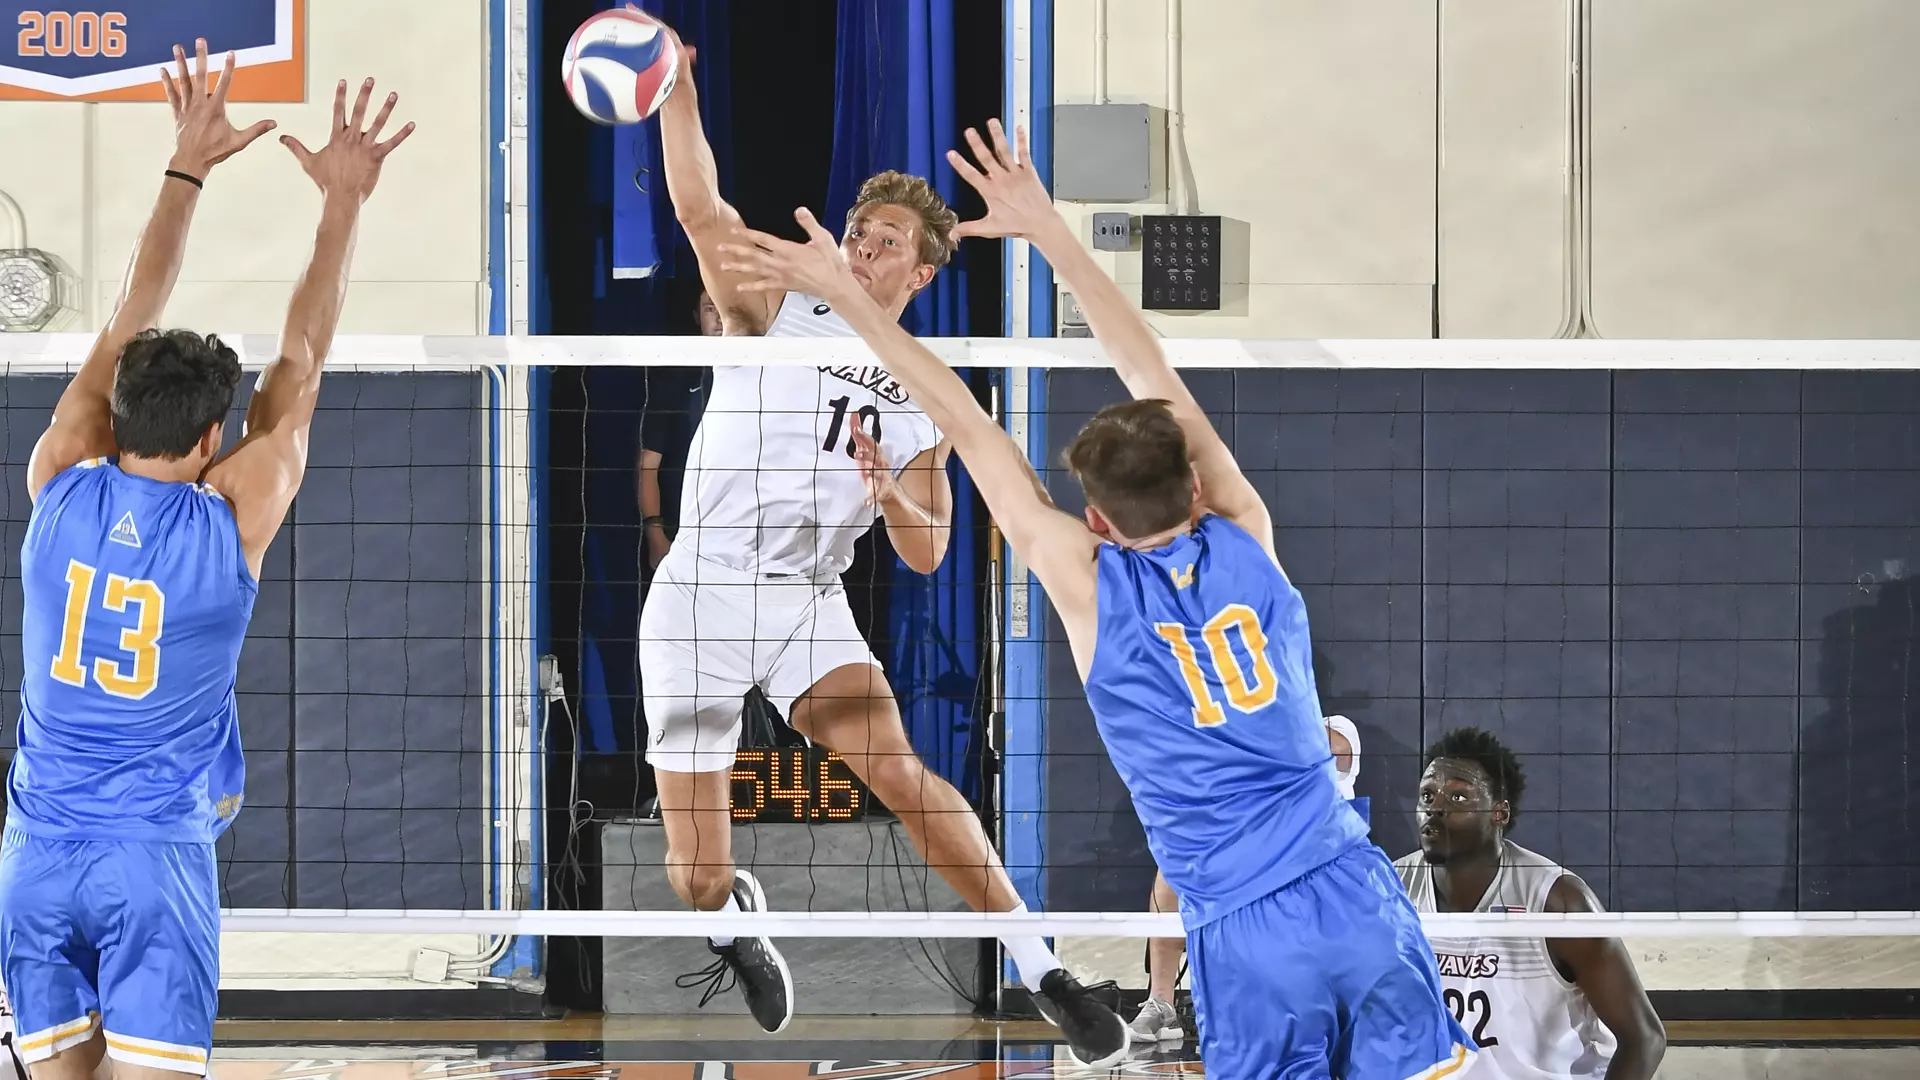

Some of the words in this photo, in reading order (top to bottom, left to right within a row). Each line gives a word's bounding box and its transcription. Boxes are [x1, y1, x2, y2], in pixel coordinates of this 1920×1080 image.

[17, 10, 128, 57] 2006
[817, 365, 909, 405] AVES
[50, 558, 165, 700] 13
[1154, 603, 1279, 728] 10
[729, 751, 859, 818] 54.6
